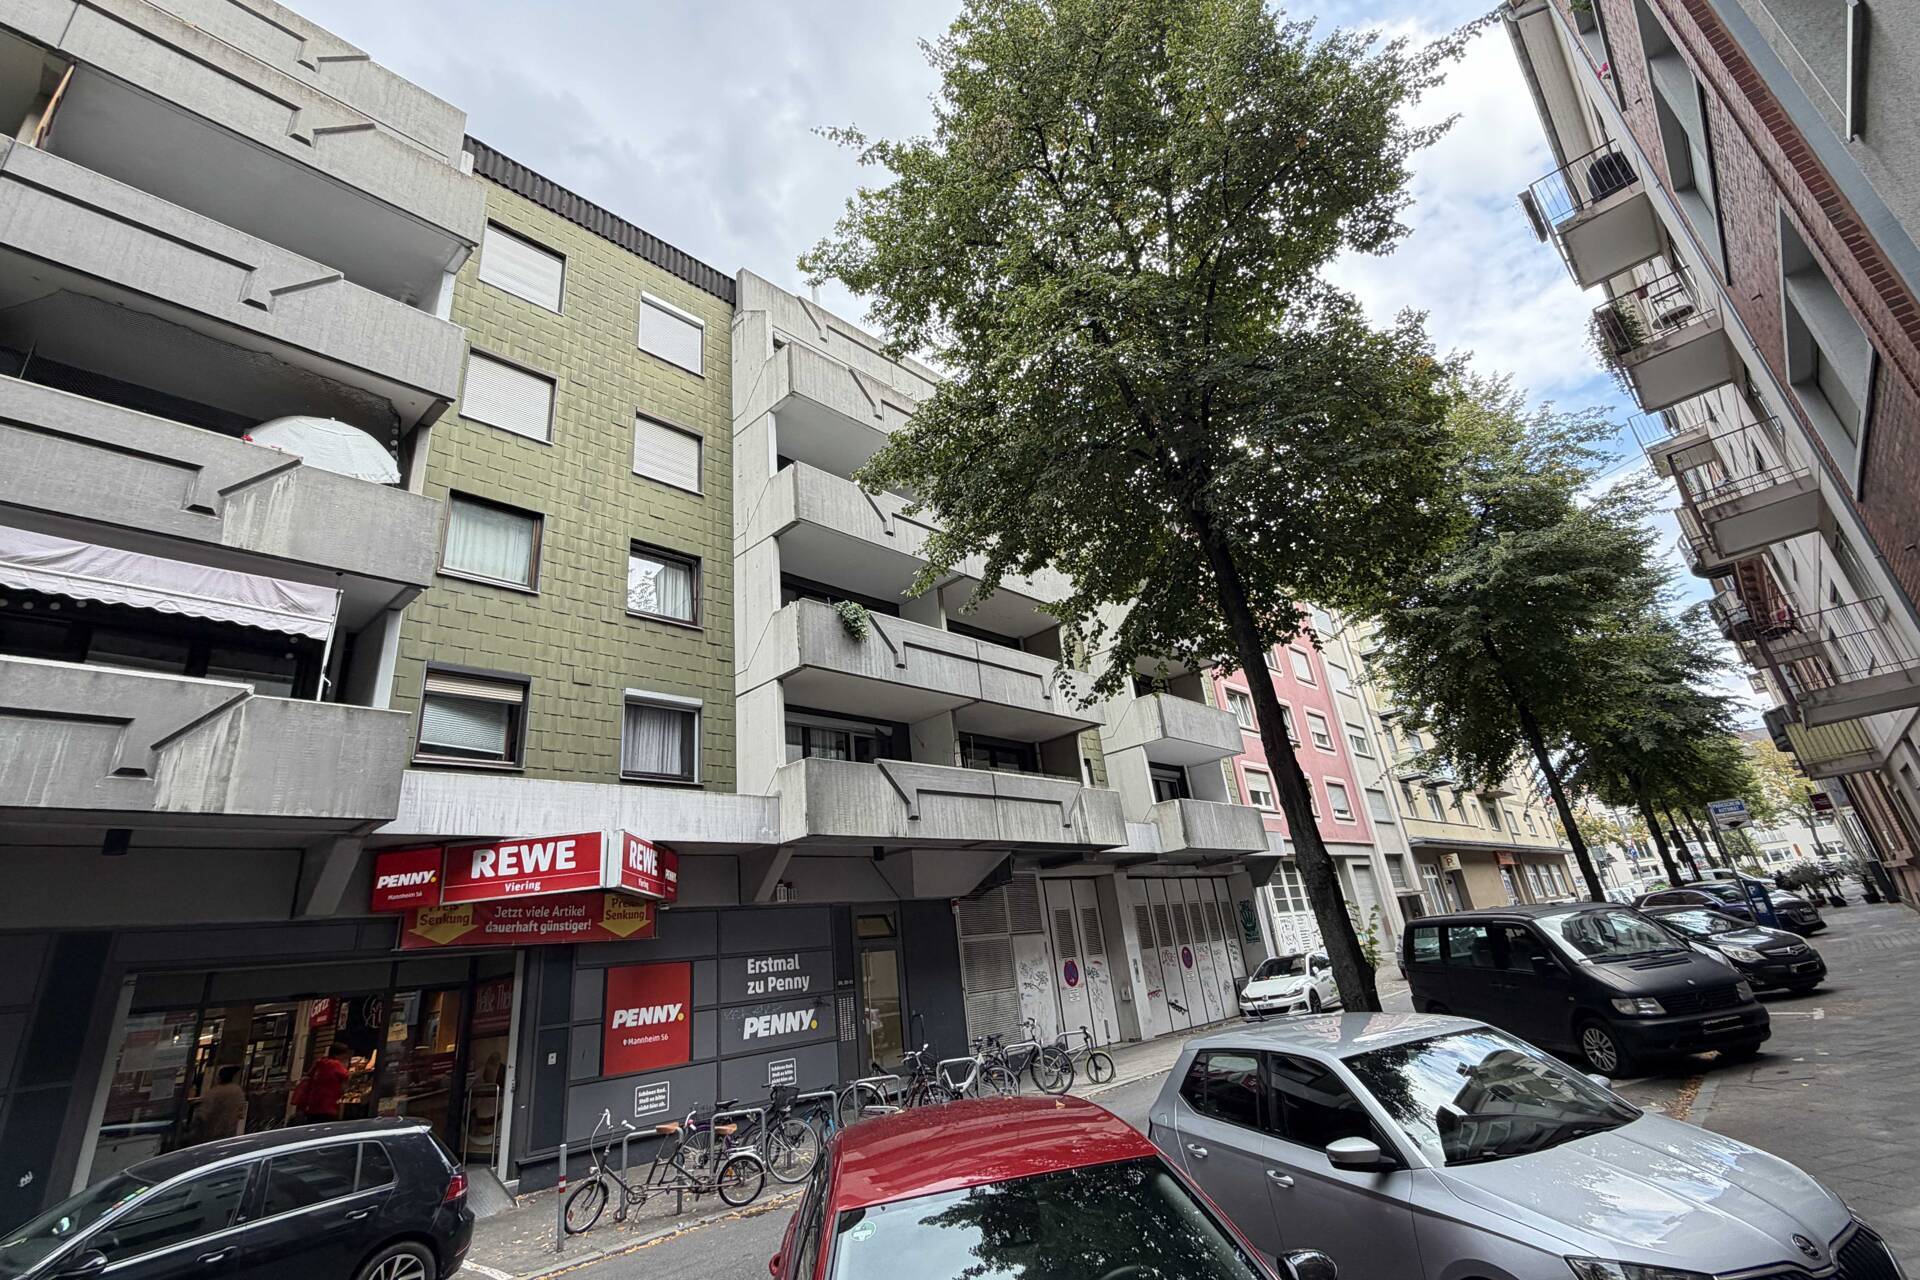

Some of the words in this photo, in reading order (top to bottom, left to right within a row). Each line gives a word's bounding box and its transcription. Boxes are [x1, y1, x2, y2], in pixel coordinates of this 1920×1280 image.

[471, 840, 576, 879] REWE
[629, 840, 658, 877] REWE
[504, 881, 541, 892] Viering
[494, 906, 522, 918] Jetzt
[525, 906, 550, 918] viele
[552, 904, 585, 917] Artikel
[605, 909, 644, 922] Senkung
[419, 913, 470, 927] Senkung
[485, 920, 538, 933] dauerhaft
[540, 919, 592, 934] günstiger!
[747, 953, 800, 974] Erstmal
[747, 980, 765, 995] zu
[767, 975, 810, 992] Penny
[628, 1034, 661, 1046] Mannheim
[661, 1033, 669, 1041] S6
